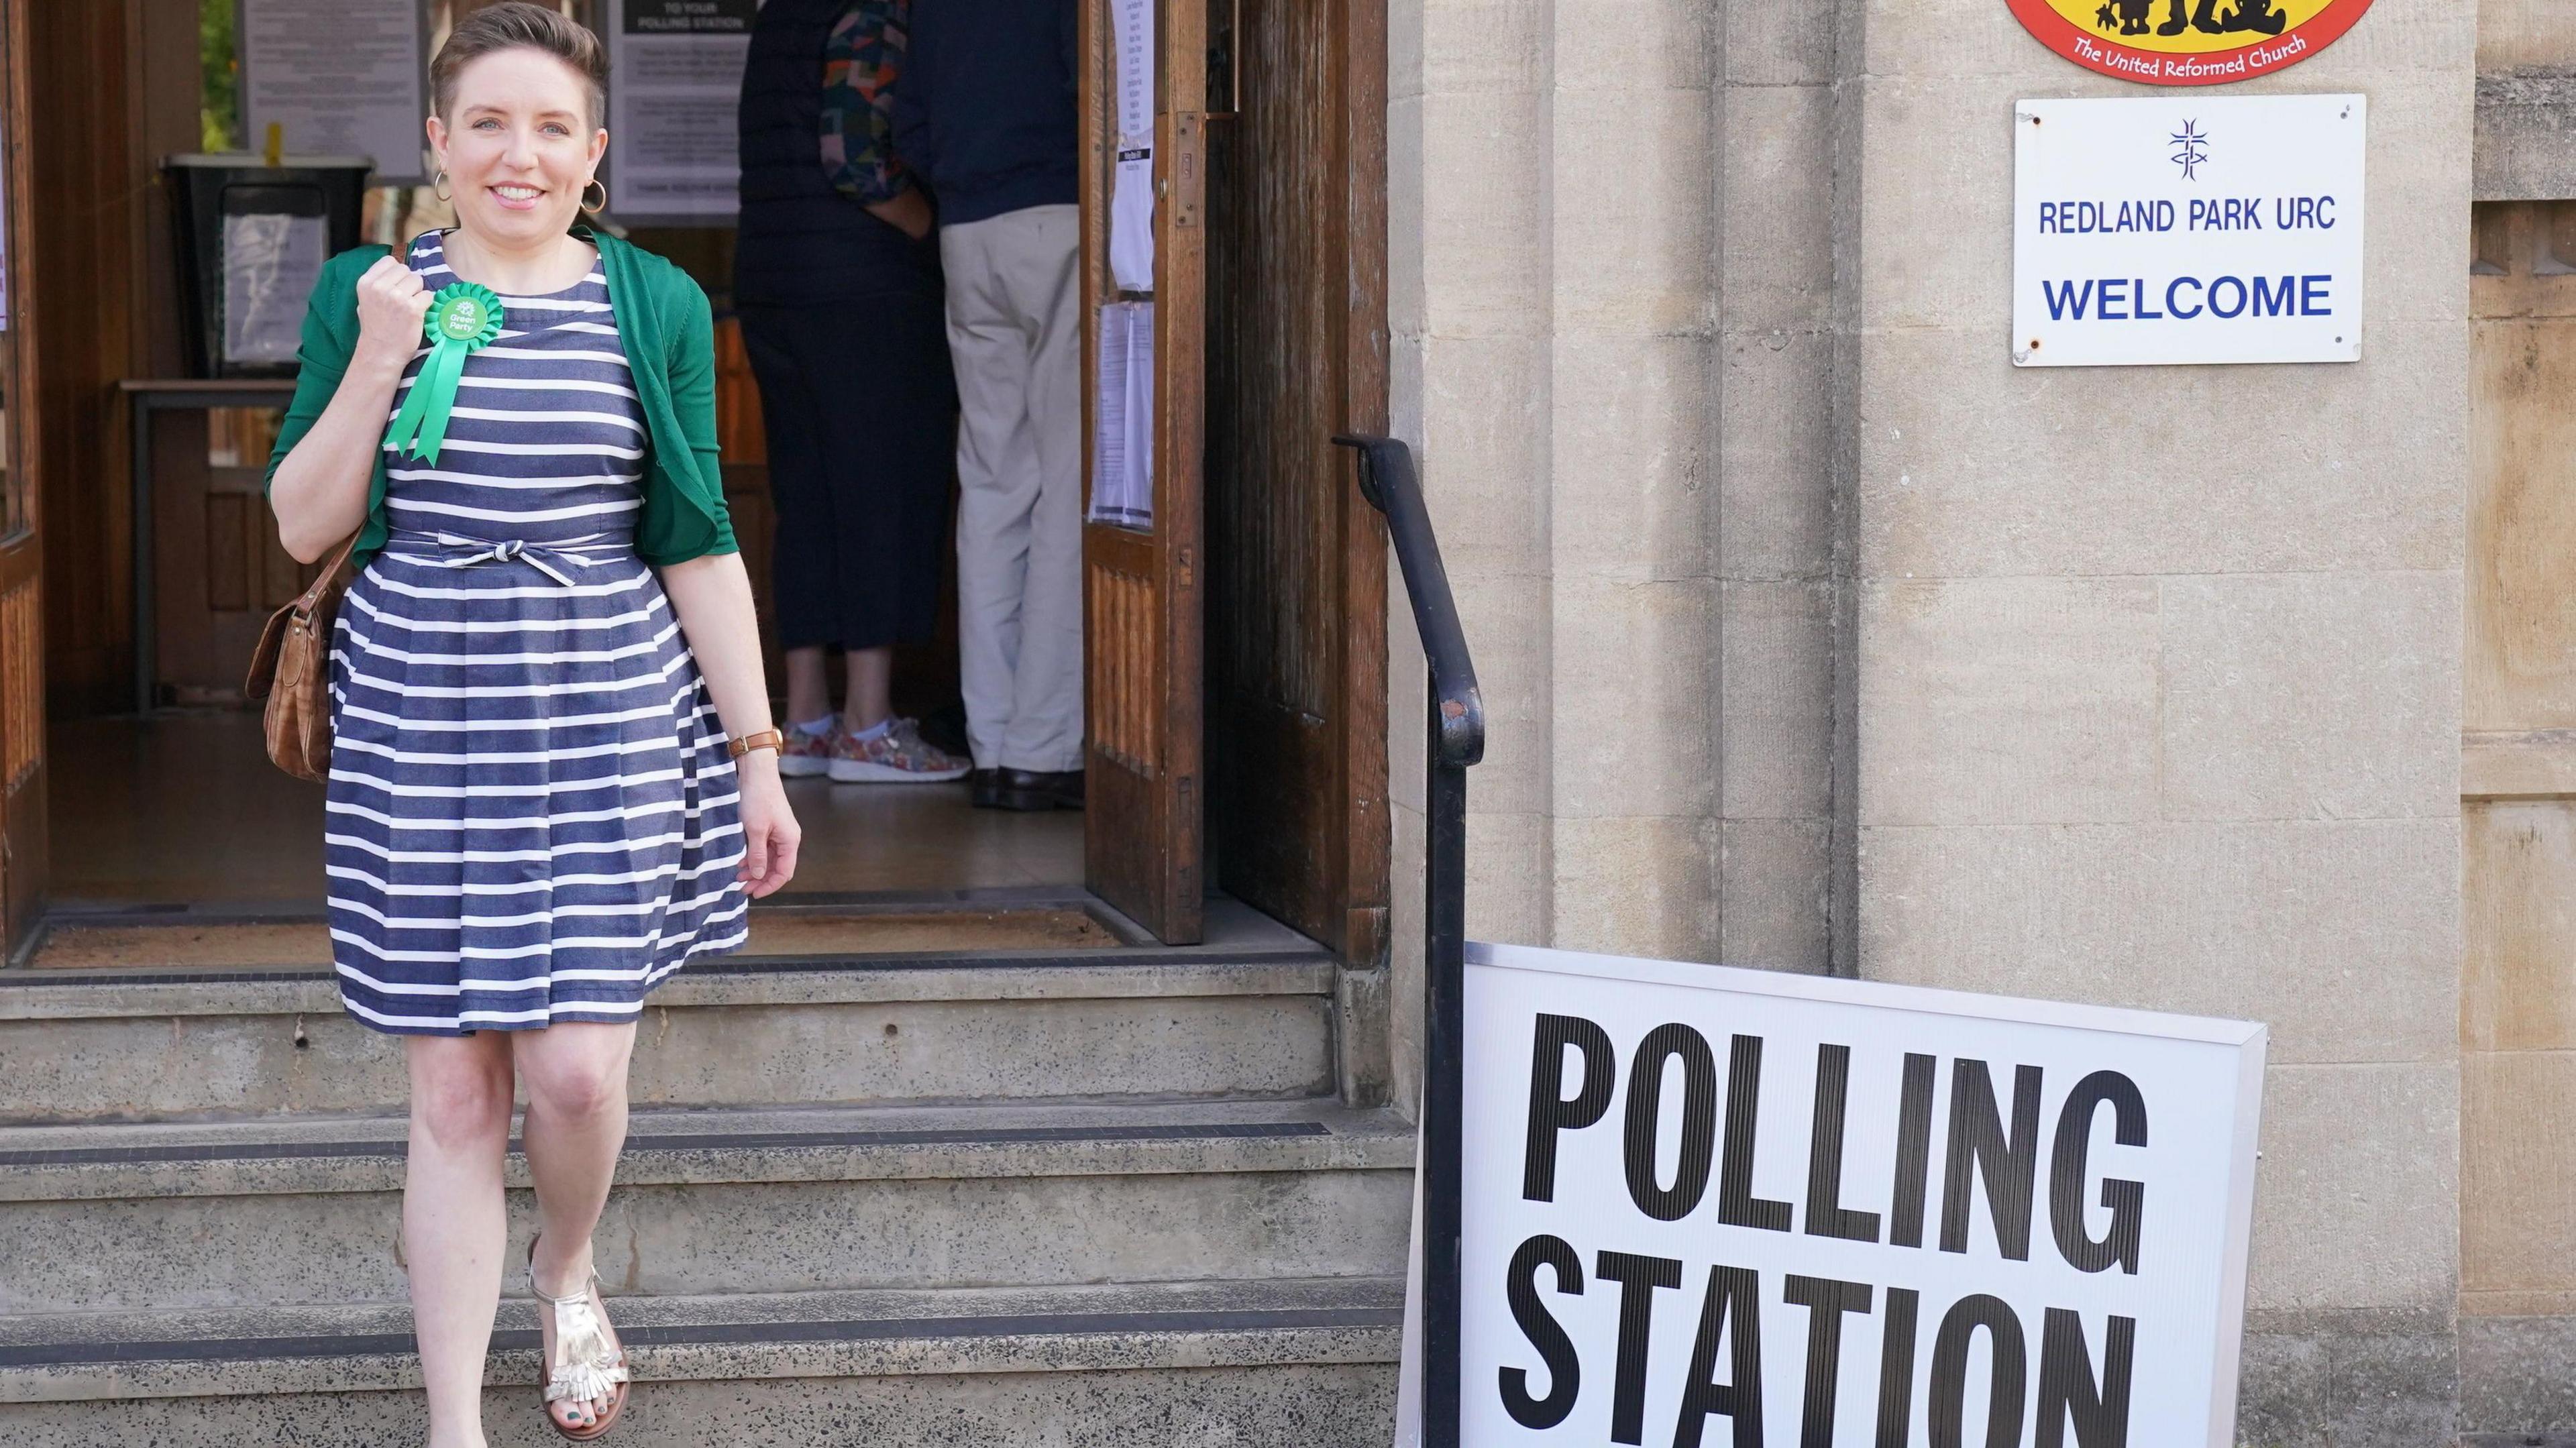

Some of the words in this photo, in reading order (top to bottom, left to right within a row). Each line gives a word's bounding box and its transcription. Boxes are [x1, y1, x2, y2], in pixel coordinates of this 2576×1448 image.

[637, 17, 690, 29] POLLING
[693, 17, 744, 29] STATION
[665, 2, 682, 14] TO
[684, 2, 718, 14] YOUR
[2074, 37, 2102, 62] The
[2105, 50, 2159, 77] United
[2165, 54, 2245, 77] Reformed
[2249, 34, 2306, 68] Church
[2039, 200, 2175, 233] REDLAND
[2190, 199, 2262, 231] PARK
[2277, 195, 2335, 230] URC
[2042, 274, 2332, 320] WELCOME
[449, 322, 473, 333] Party
[450, 314, 476, 324] Green
[1523, 1013, 2148, 1275] POLLING
[1498, 1234, 2136, 1448] STATION
